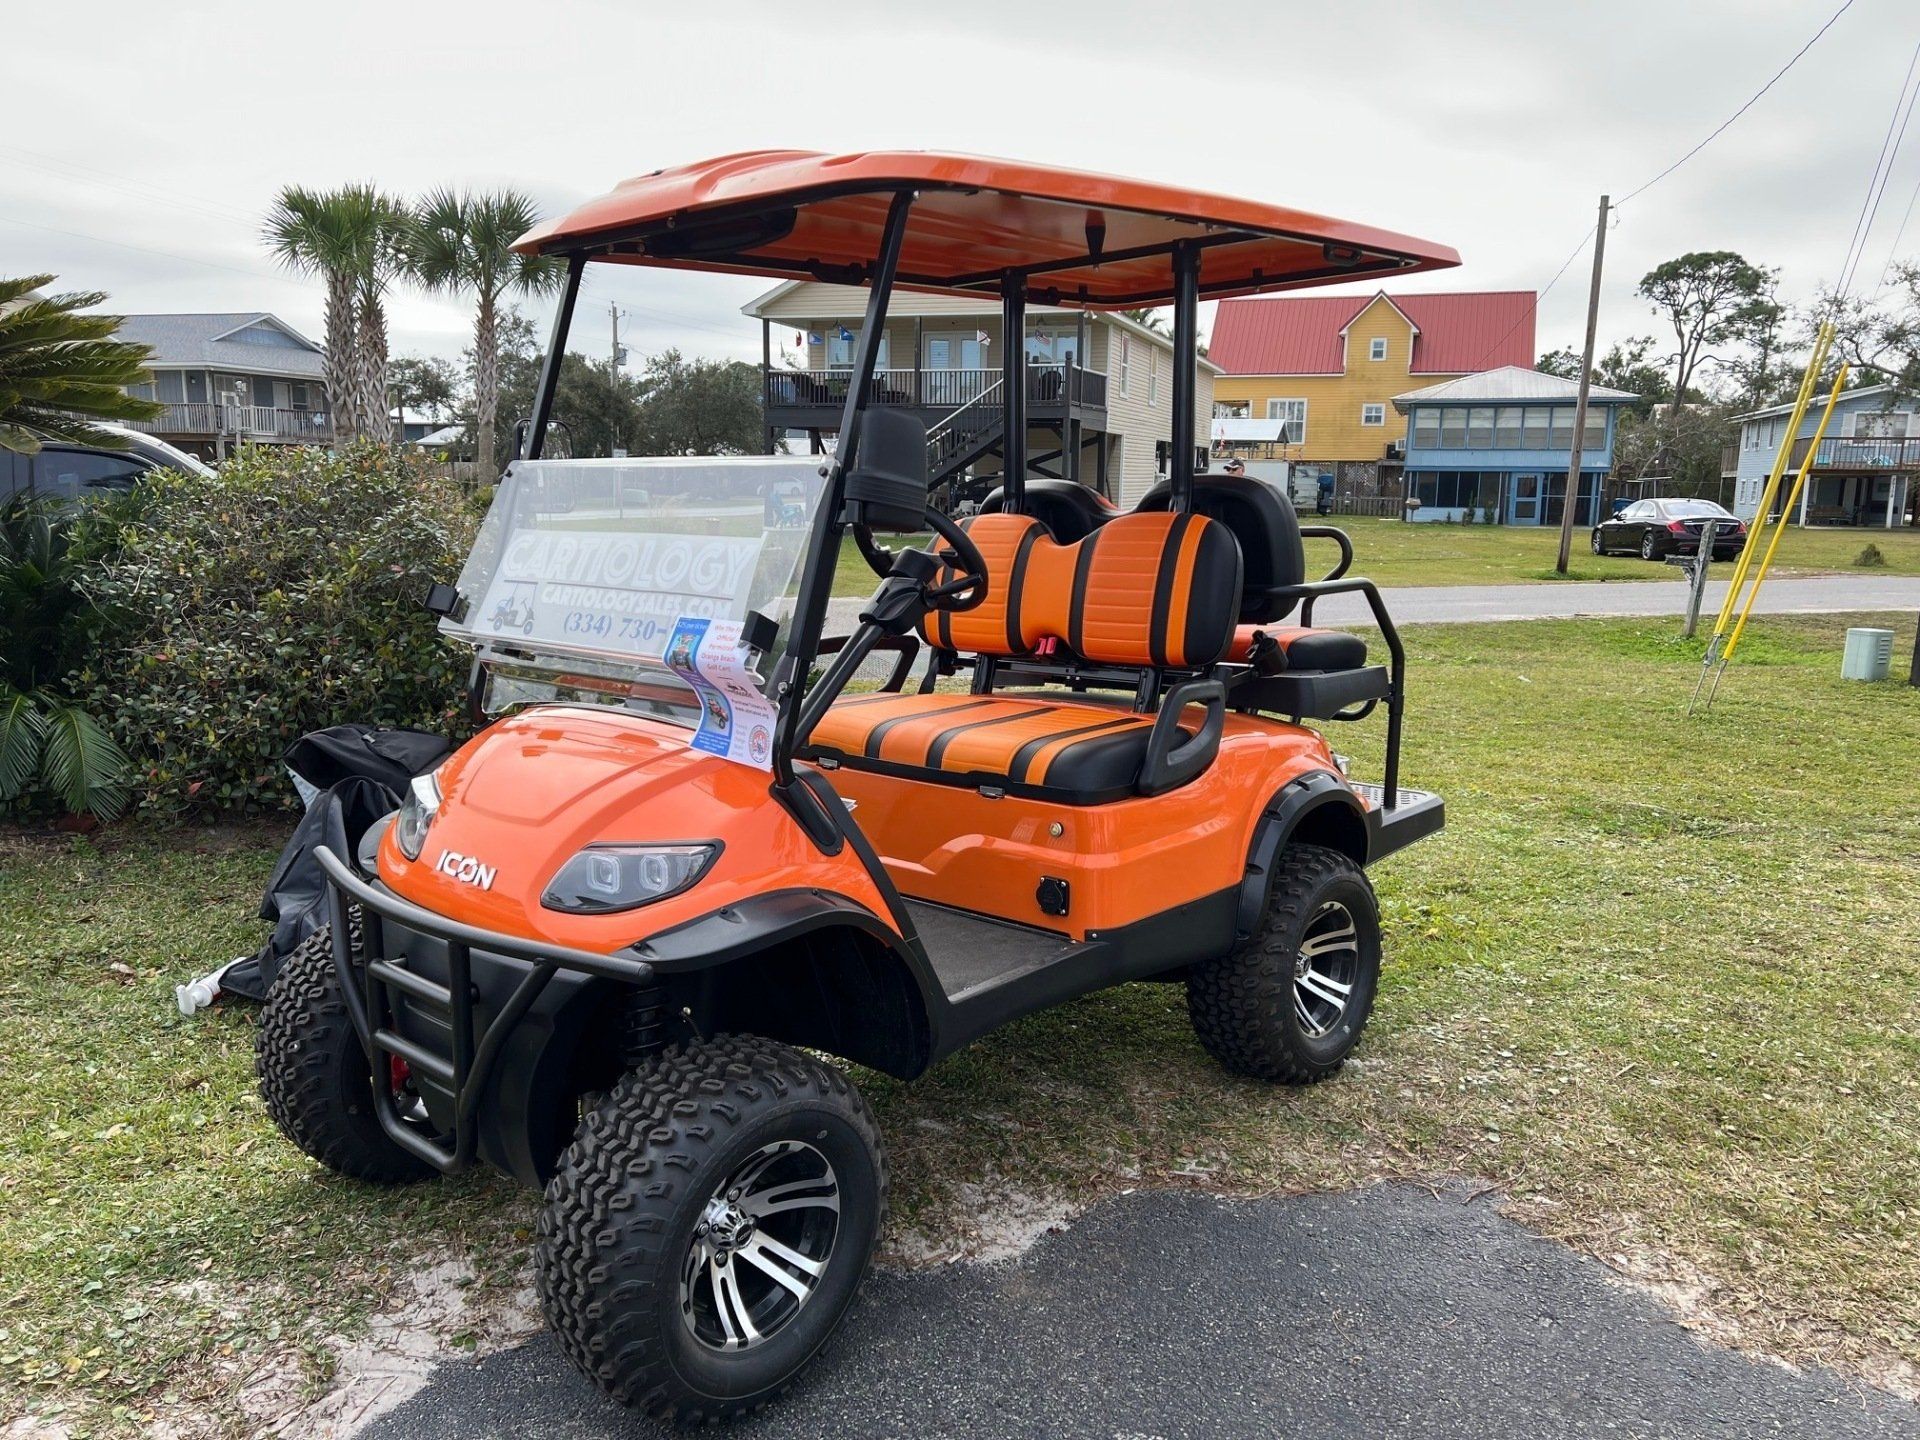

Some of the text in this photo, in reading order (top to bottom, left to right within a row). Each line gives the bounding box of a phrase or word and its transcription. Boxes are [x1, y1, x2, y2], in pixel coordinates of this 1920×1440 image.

[502, 534, 757, 597] CARTIOLOGY
[563, 611, 674, 641] (334) 730-
[701, 652, 736, 663] Orange Beach
[435, 848, 498, 891] ICON
